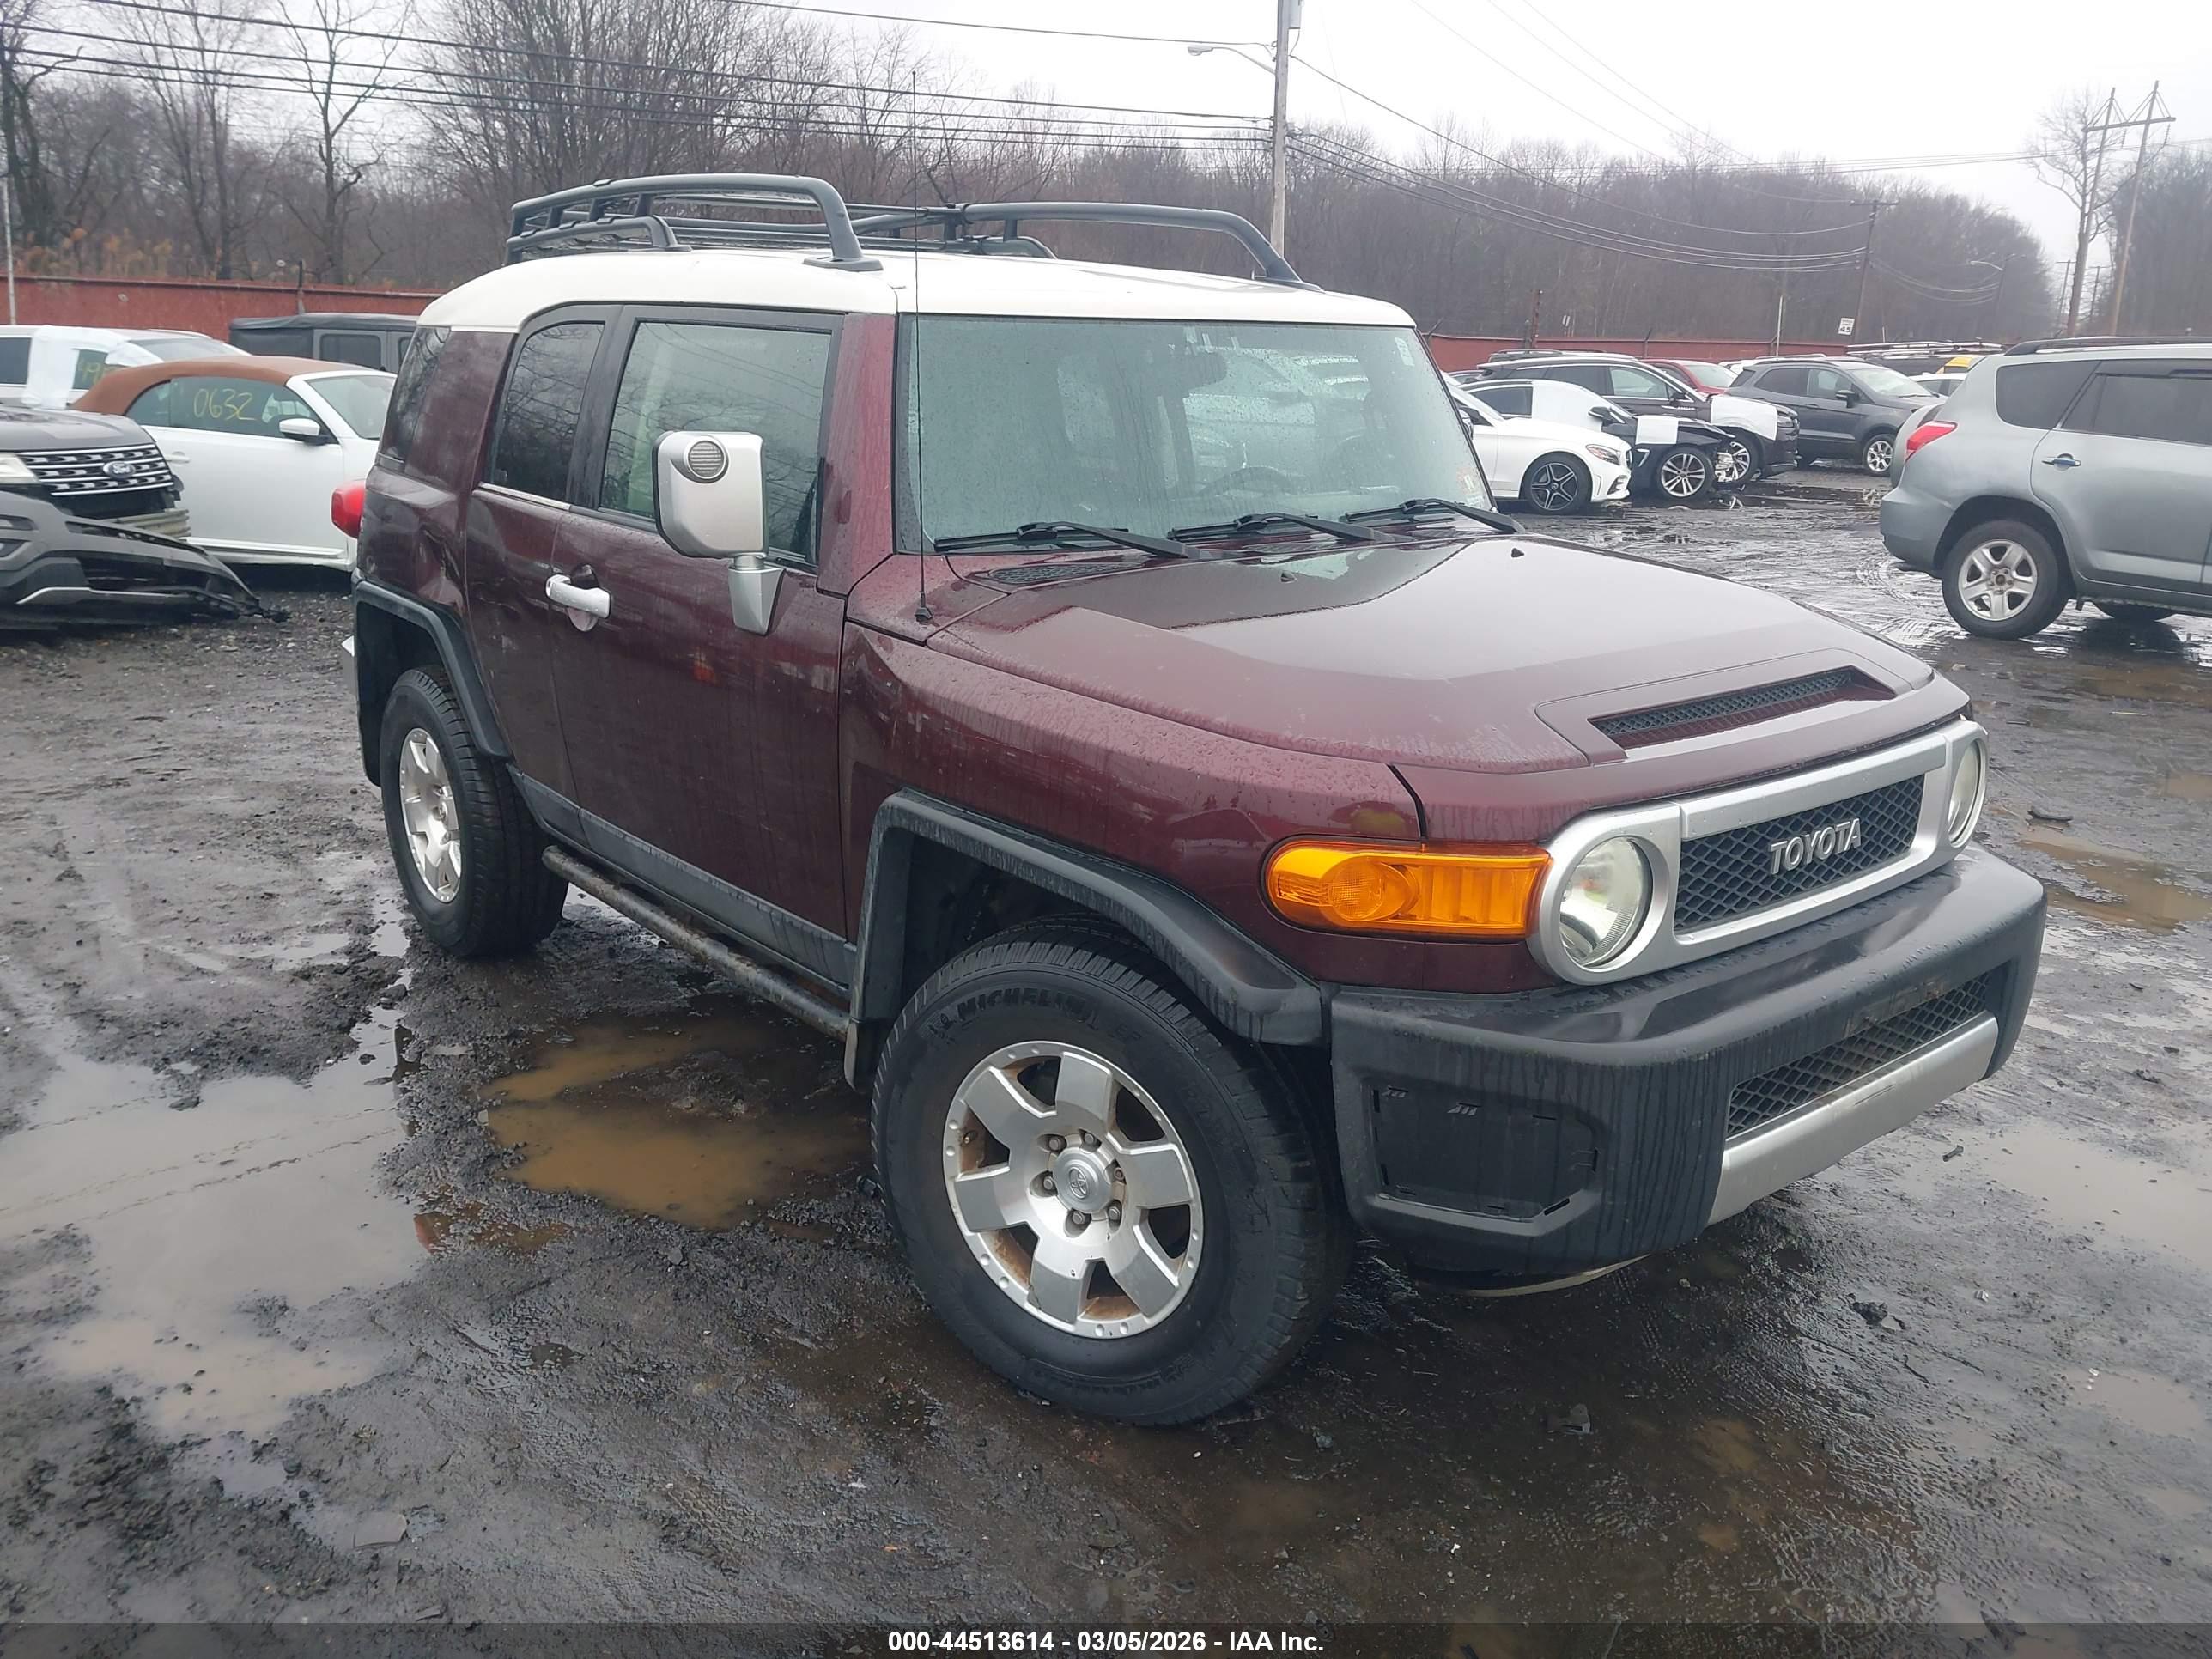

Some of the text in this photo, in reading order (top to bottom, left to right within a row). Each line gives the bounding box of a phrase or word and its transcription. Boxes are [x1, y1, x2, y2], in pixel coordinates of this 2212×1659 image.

[193, 388, 256, 421] 0632
[1770, 818, 1862, 874] TOYOTA
[957, 988, 1086, 1020] MICHELIN
